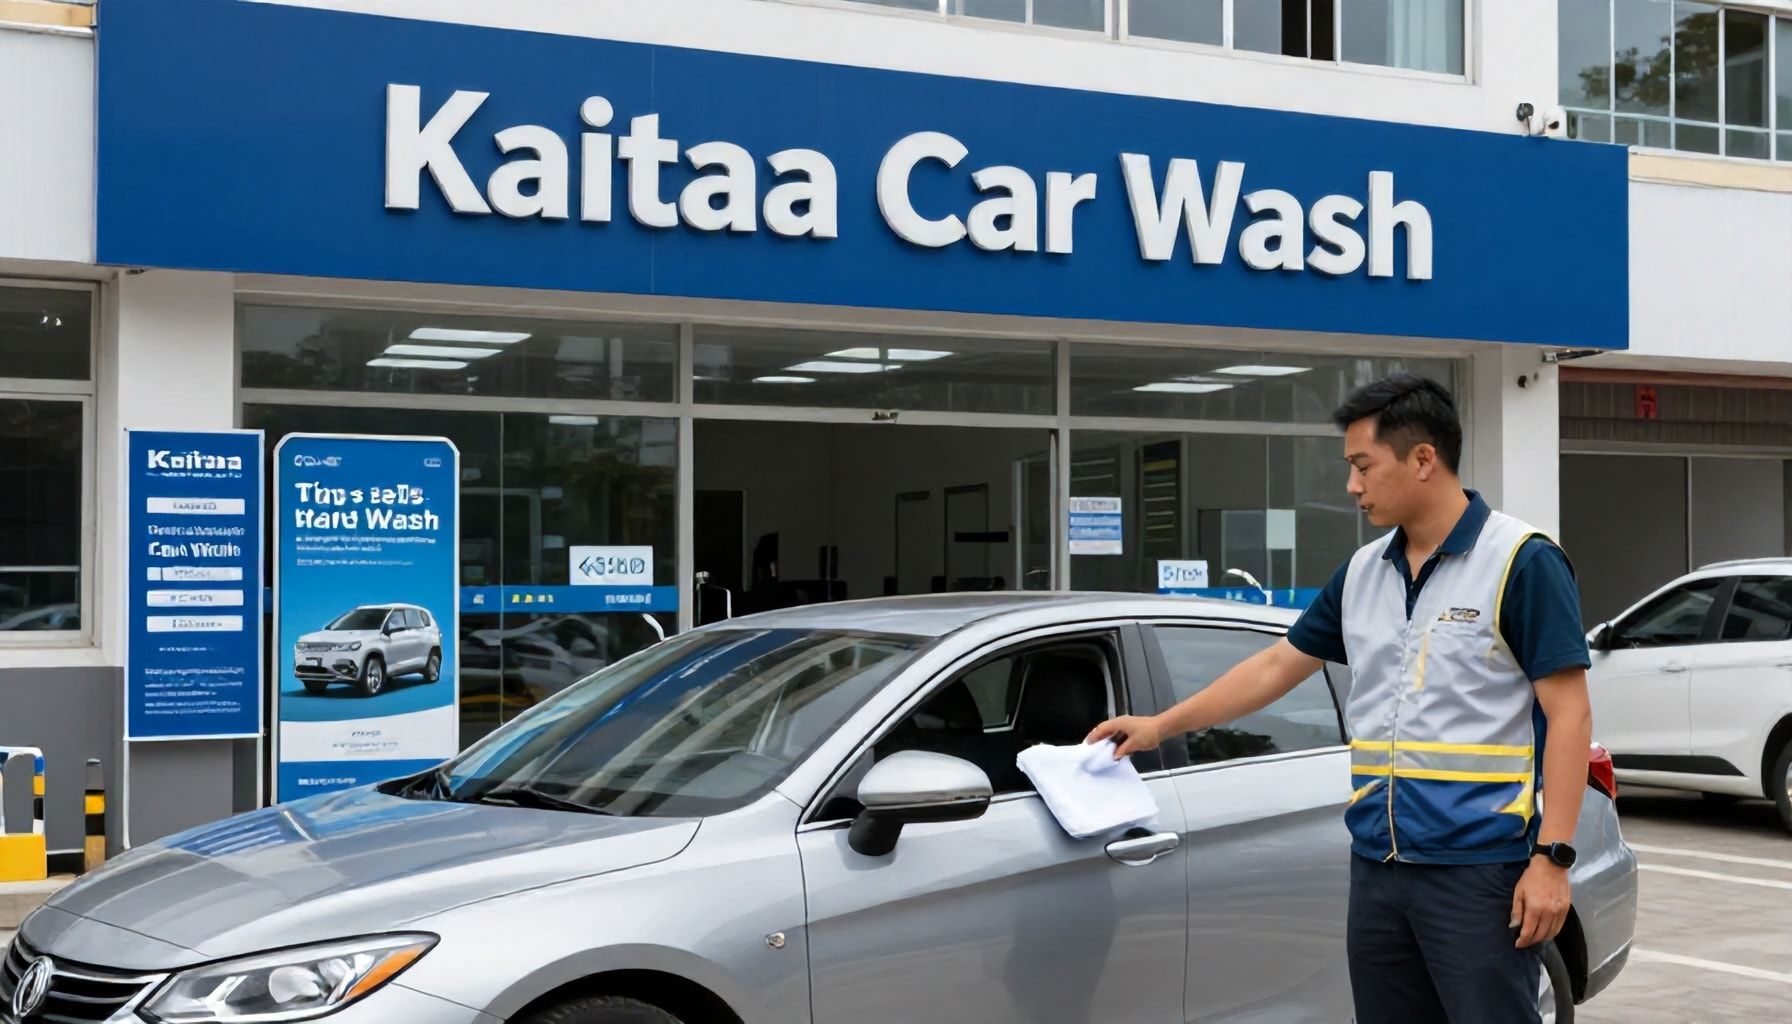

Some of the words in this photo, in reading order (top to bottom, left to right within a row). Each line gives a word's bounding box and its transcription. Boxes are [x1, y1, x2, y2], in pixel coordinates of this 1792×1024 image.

[385, 83, 838, 238] Kaitaa
[876, 130, 1097, 254] Car
[1119, 152, 1433, 280] Wash
[364, 507, 440, 531] Wash
